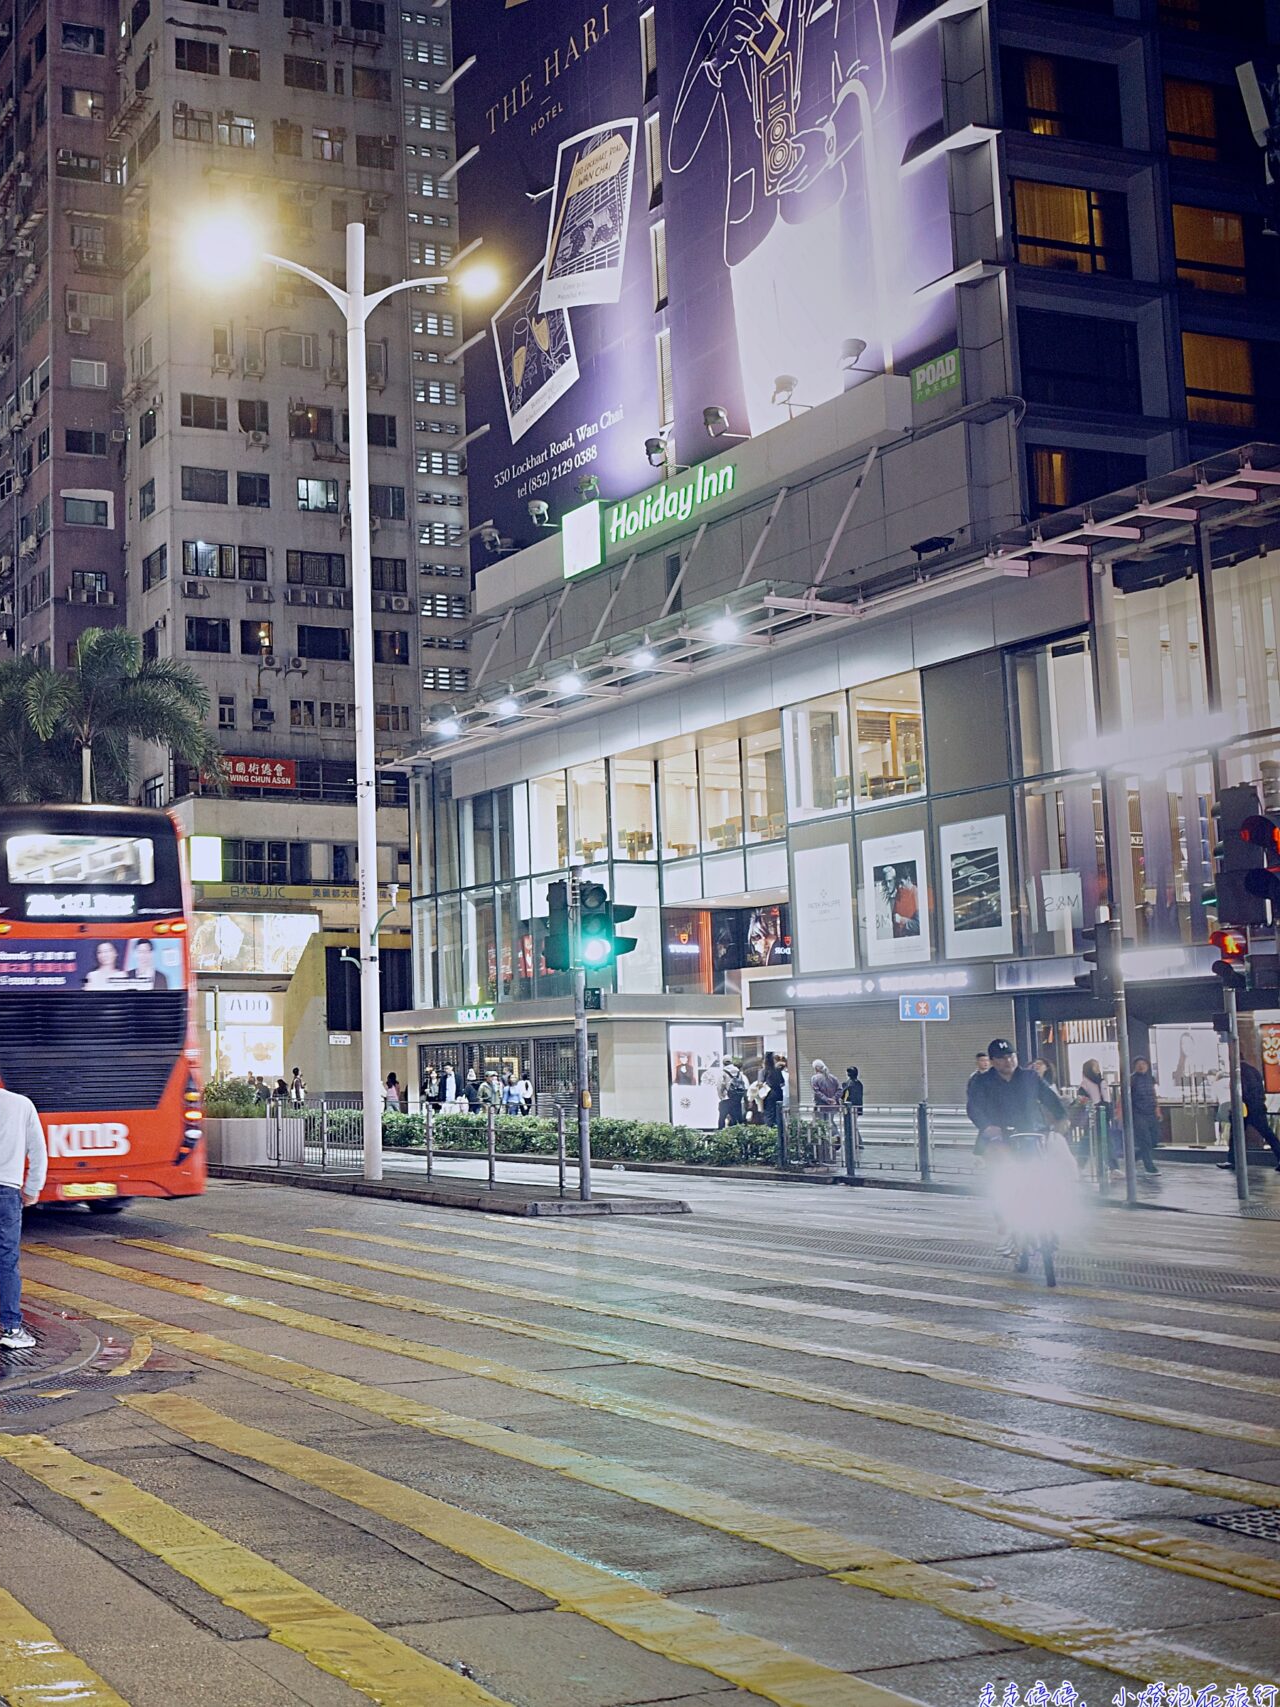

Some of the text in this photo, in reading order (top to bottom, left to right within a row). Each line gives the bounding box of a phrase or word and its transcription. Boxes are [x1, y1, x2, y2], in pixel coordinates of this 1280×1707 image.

[486, 4, 610, 135] THE HARI
[530, 102, 563, 136] HOTEL
[916, 354, 956, 391] POAD
[494, 404, 624, 489] 330 Lockhart Road, Wan Chai
[517, 444, 598, 498] tel (852) 2129 0388
[610, 465, 733, 543] Holiday Inn
[230, 774, 249, 783] WING
[250, 775, 271, 784] CHUN
[272, 777, 291, 785] ASSN
[231, 886, 261, 897] 日本城
[457, 1007, 495, 1024] ROLEX
[47, 1123, 131, 1158] KMB
